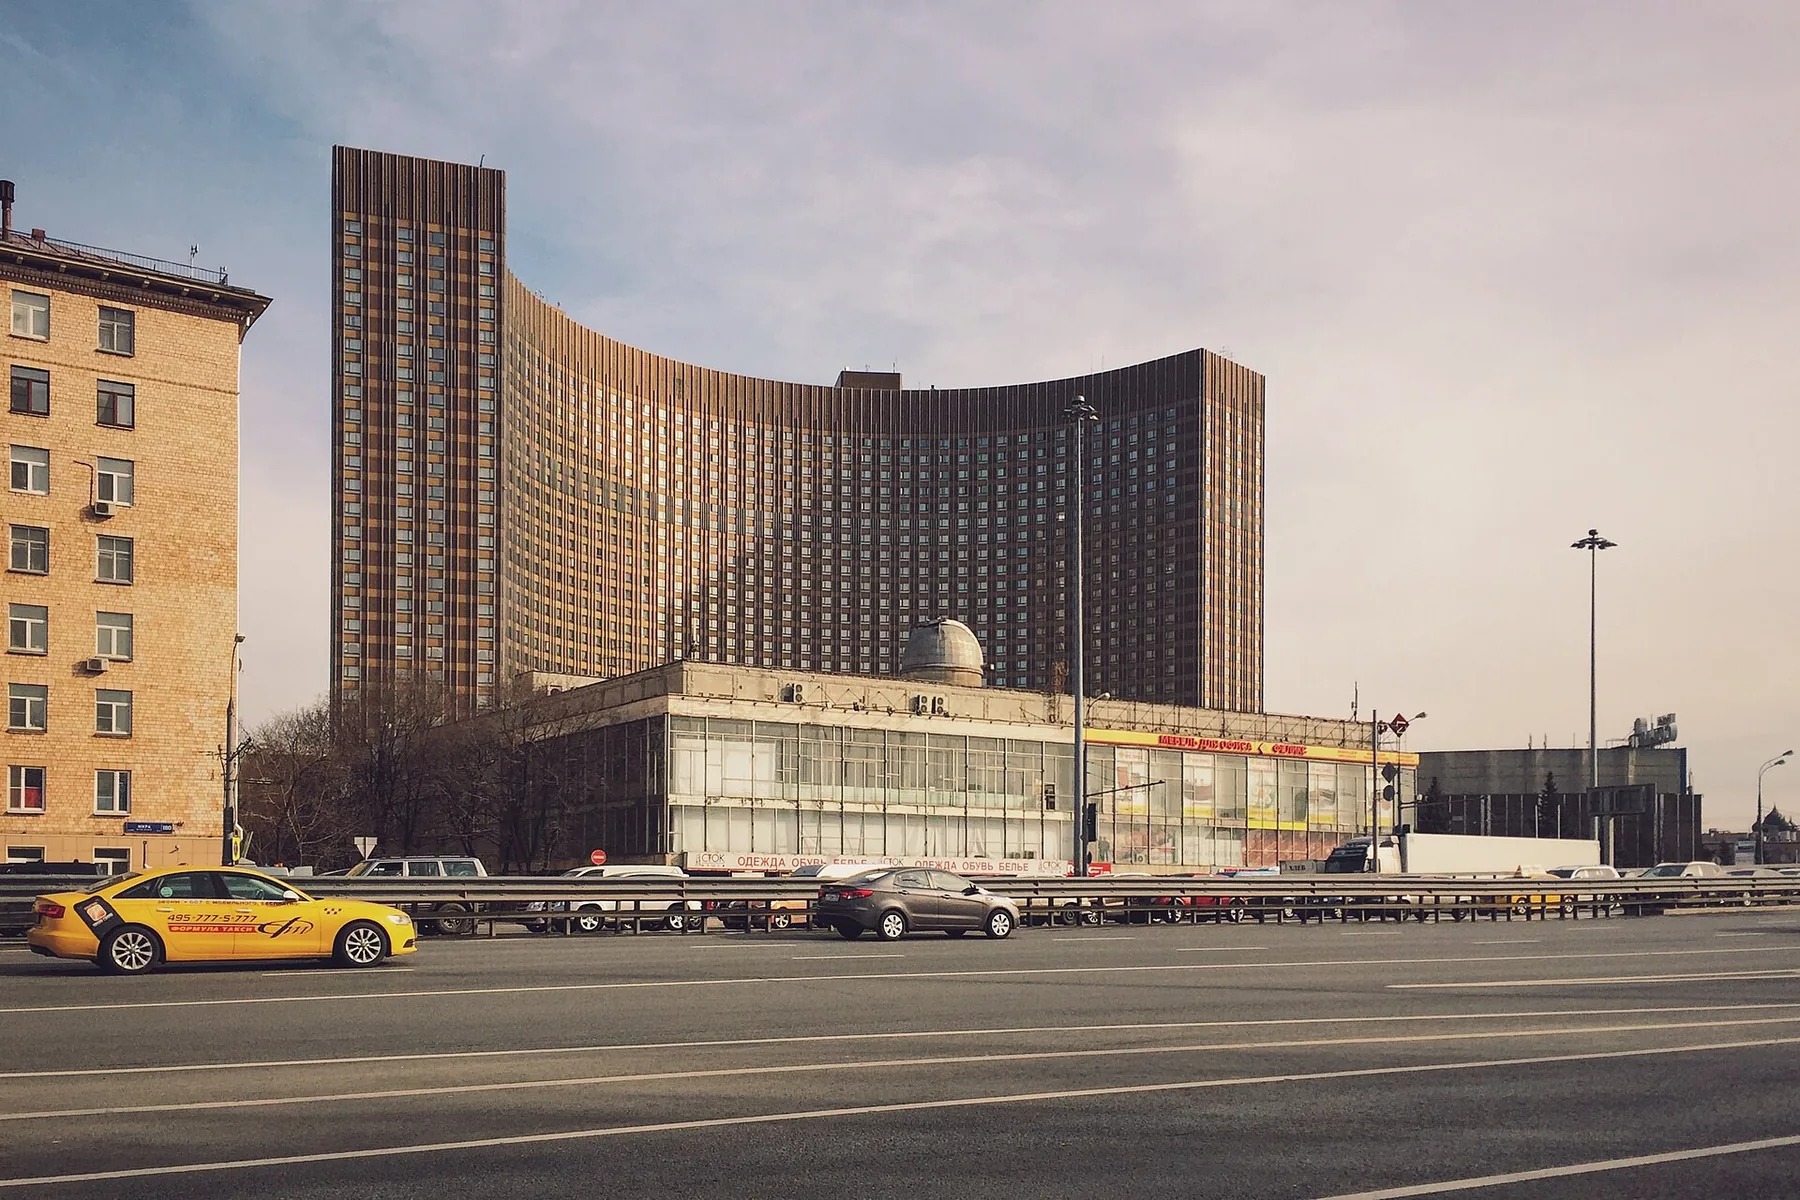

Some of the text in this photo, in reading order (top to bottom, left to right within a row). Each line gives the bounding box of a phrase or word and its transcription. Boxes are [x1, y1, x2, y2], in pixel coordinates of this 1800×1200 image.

[1158, 735, 1198, 747] МЕБЕЛЬ
[701, 853, 725, 863] СТОК
[737, 856, 786, 868] ОДЕЖДА
[914, 860, 1029, 872] ОДЕЖДА ОБУВЬ БЕЛЬЕ
[1042, 861, 1061, 871] СТОК
[167, 914, 258, 922] 495-777-5-777
